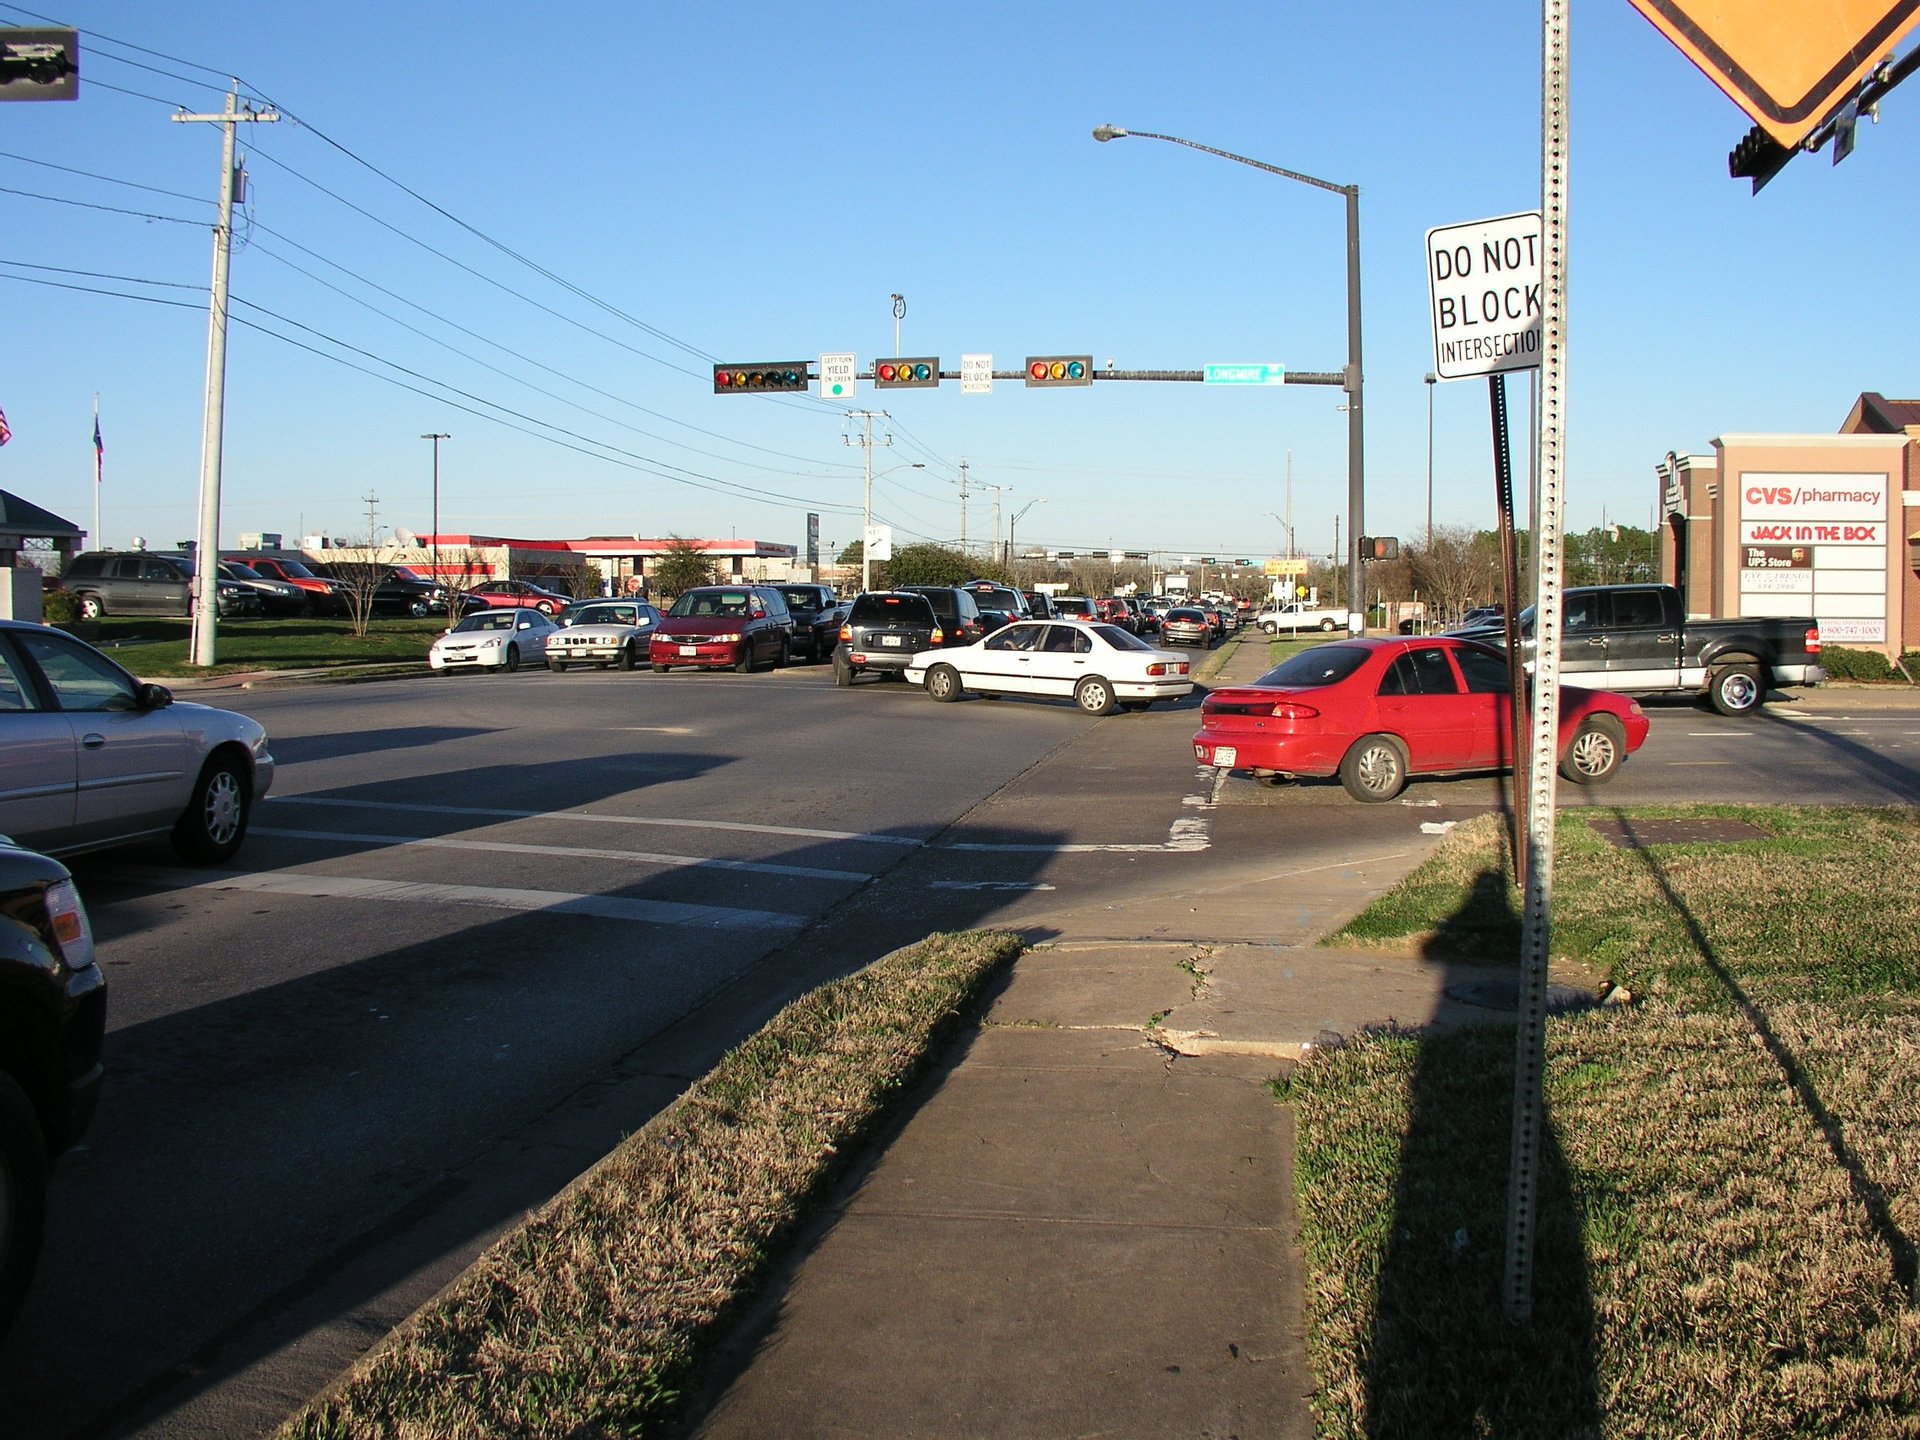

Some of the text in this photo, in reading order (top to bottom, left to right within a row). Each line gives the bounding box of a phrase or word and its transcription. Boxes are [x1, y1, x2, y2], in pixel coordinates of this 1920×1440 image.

[1435, 234, 1538, 281] DO NOT
[1439, 283, 1541, 329] BLOCK
[1441, 329, 1541, 364] INTERSECTIO
[828, 365, 849, 374] YIELD
[963, 360, 989, 370] DO NOT
[963, 372, 990, 381] BLOCK
[1751, 526, 1792, 541] JACK
[1815, 526, 1840, 540] THE
[1844, 526, 1876, 541] BOX
[1748, 548, 1765, 557] The
[1748, 557, 1792, 567] UPS Store
